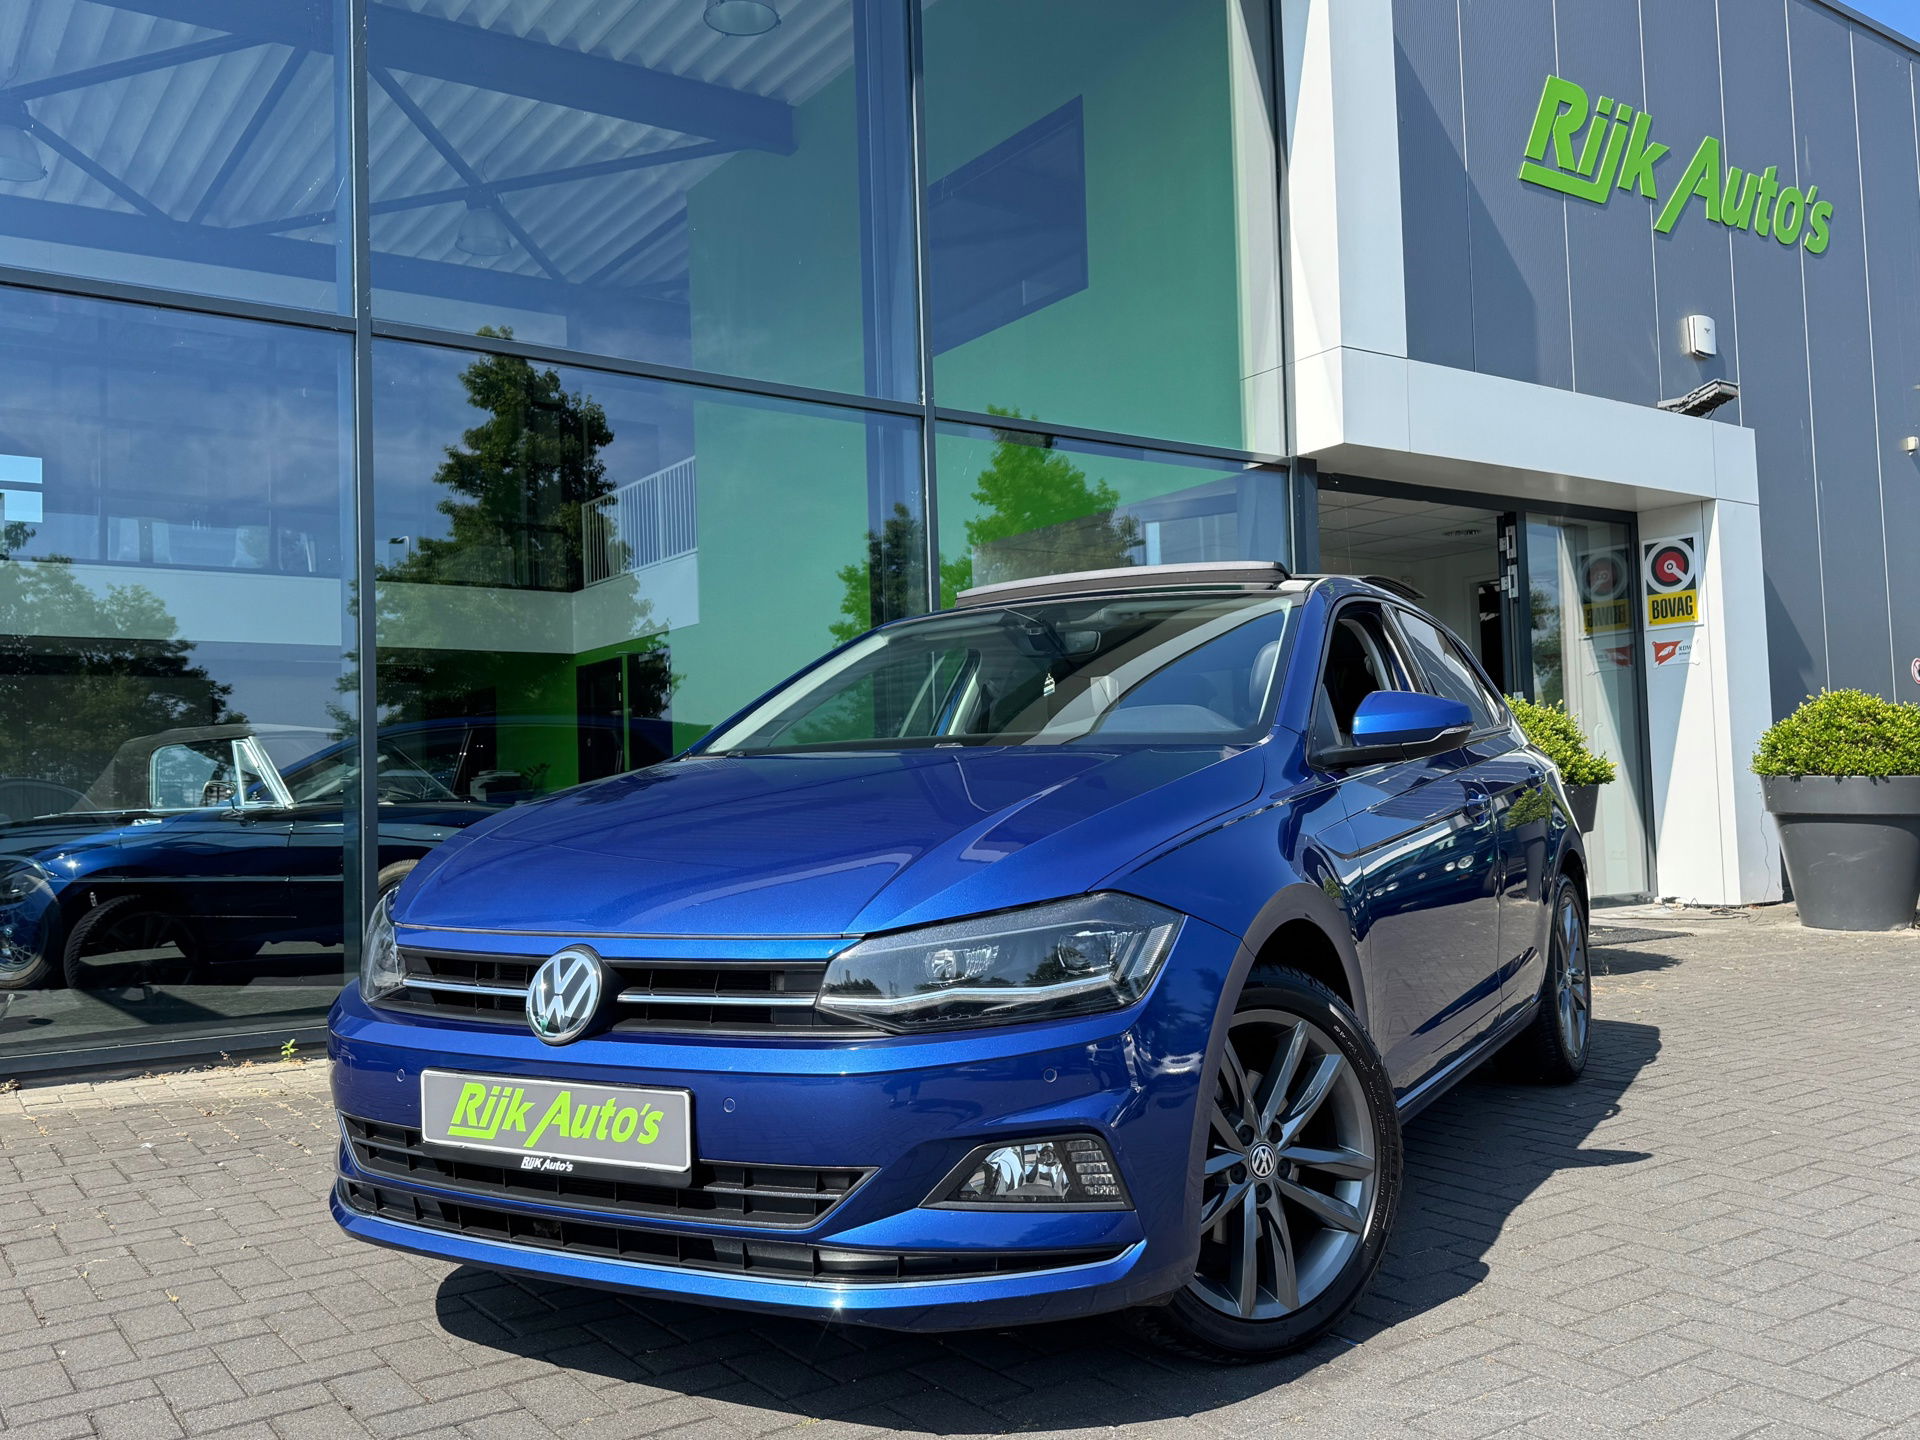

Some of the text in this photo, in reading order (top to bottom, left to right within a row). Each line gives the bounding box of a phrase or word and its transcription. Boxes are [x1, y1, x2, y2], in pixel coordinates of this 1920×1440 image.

[1518, 74, 1834, 254] Rijk Auto's
[1651, 594, 1694, 620] BOVAG
[530, 950, 599, 1039] VW
[447, 1081, 665, 1148] Rijk Auto's
[540, 1159, 574, 1172] Auto's
